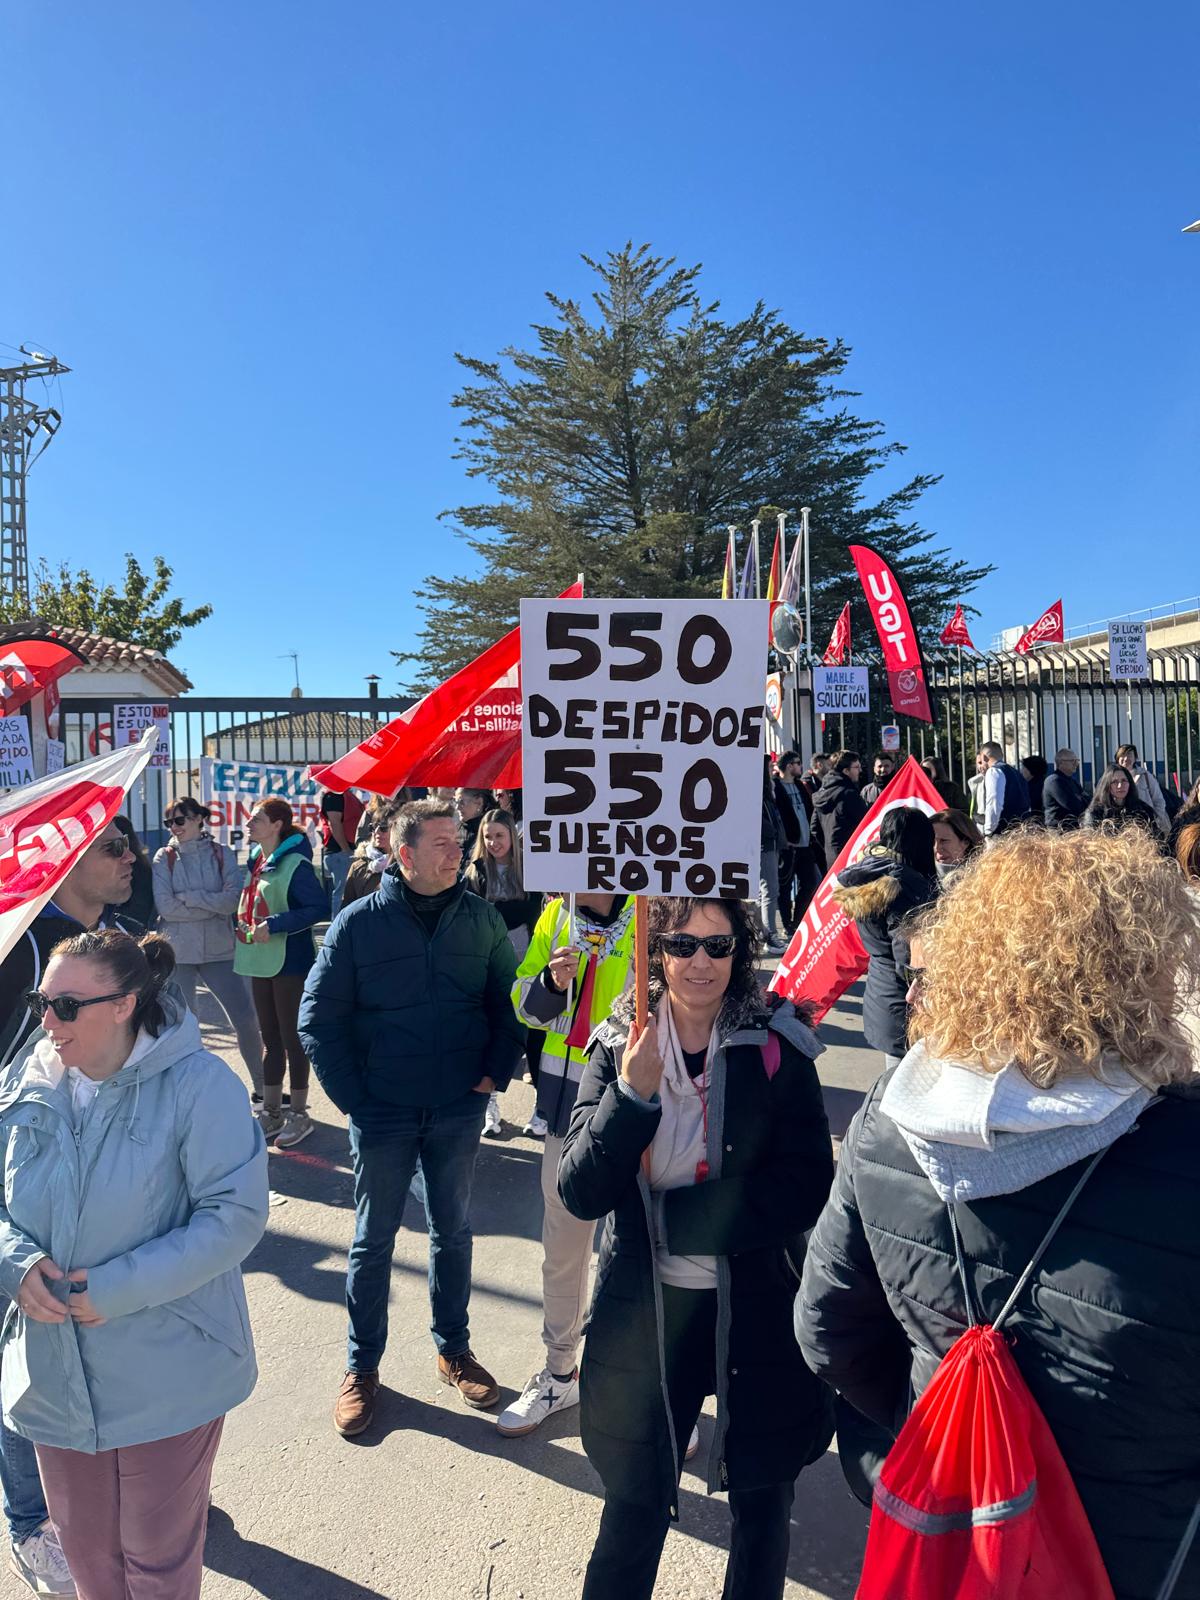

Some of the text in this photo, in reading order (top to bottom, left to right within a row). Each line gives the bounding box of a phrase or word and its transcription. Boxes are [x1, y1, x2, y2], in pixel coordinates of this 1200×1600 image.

[546, 612, 732, 684] 550
[118, 706, 168, 718] ESTO NO
[544, 749, 728, 823] 550
[529, 820, 705, 859] SUEÑOS
[587, 857, 749, 898] ROTOS
